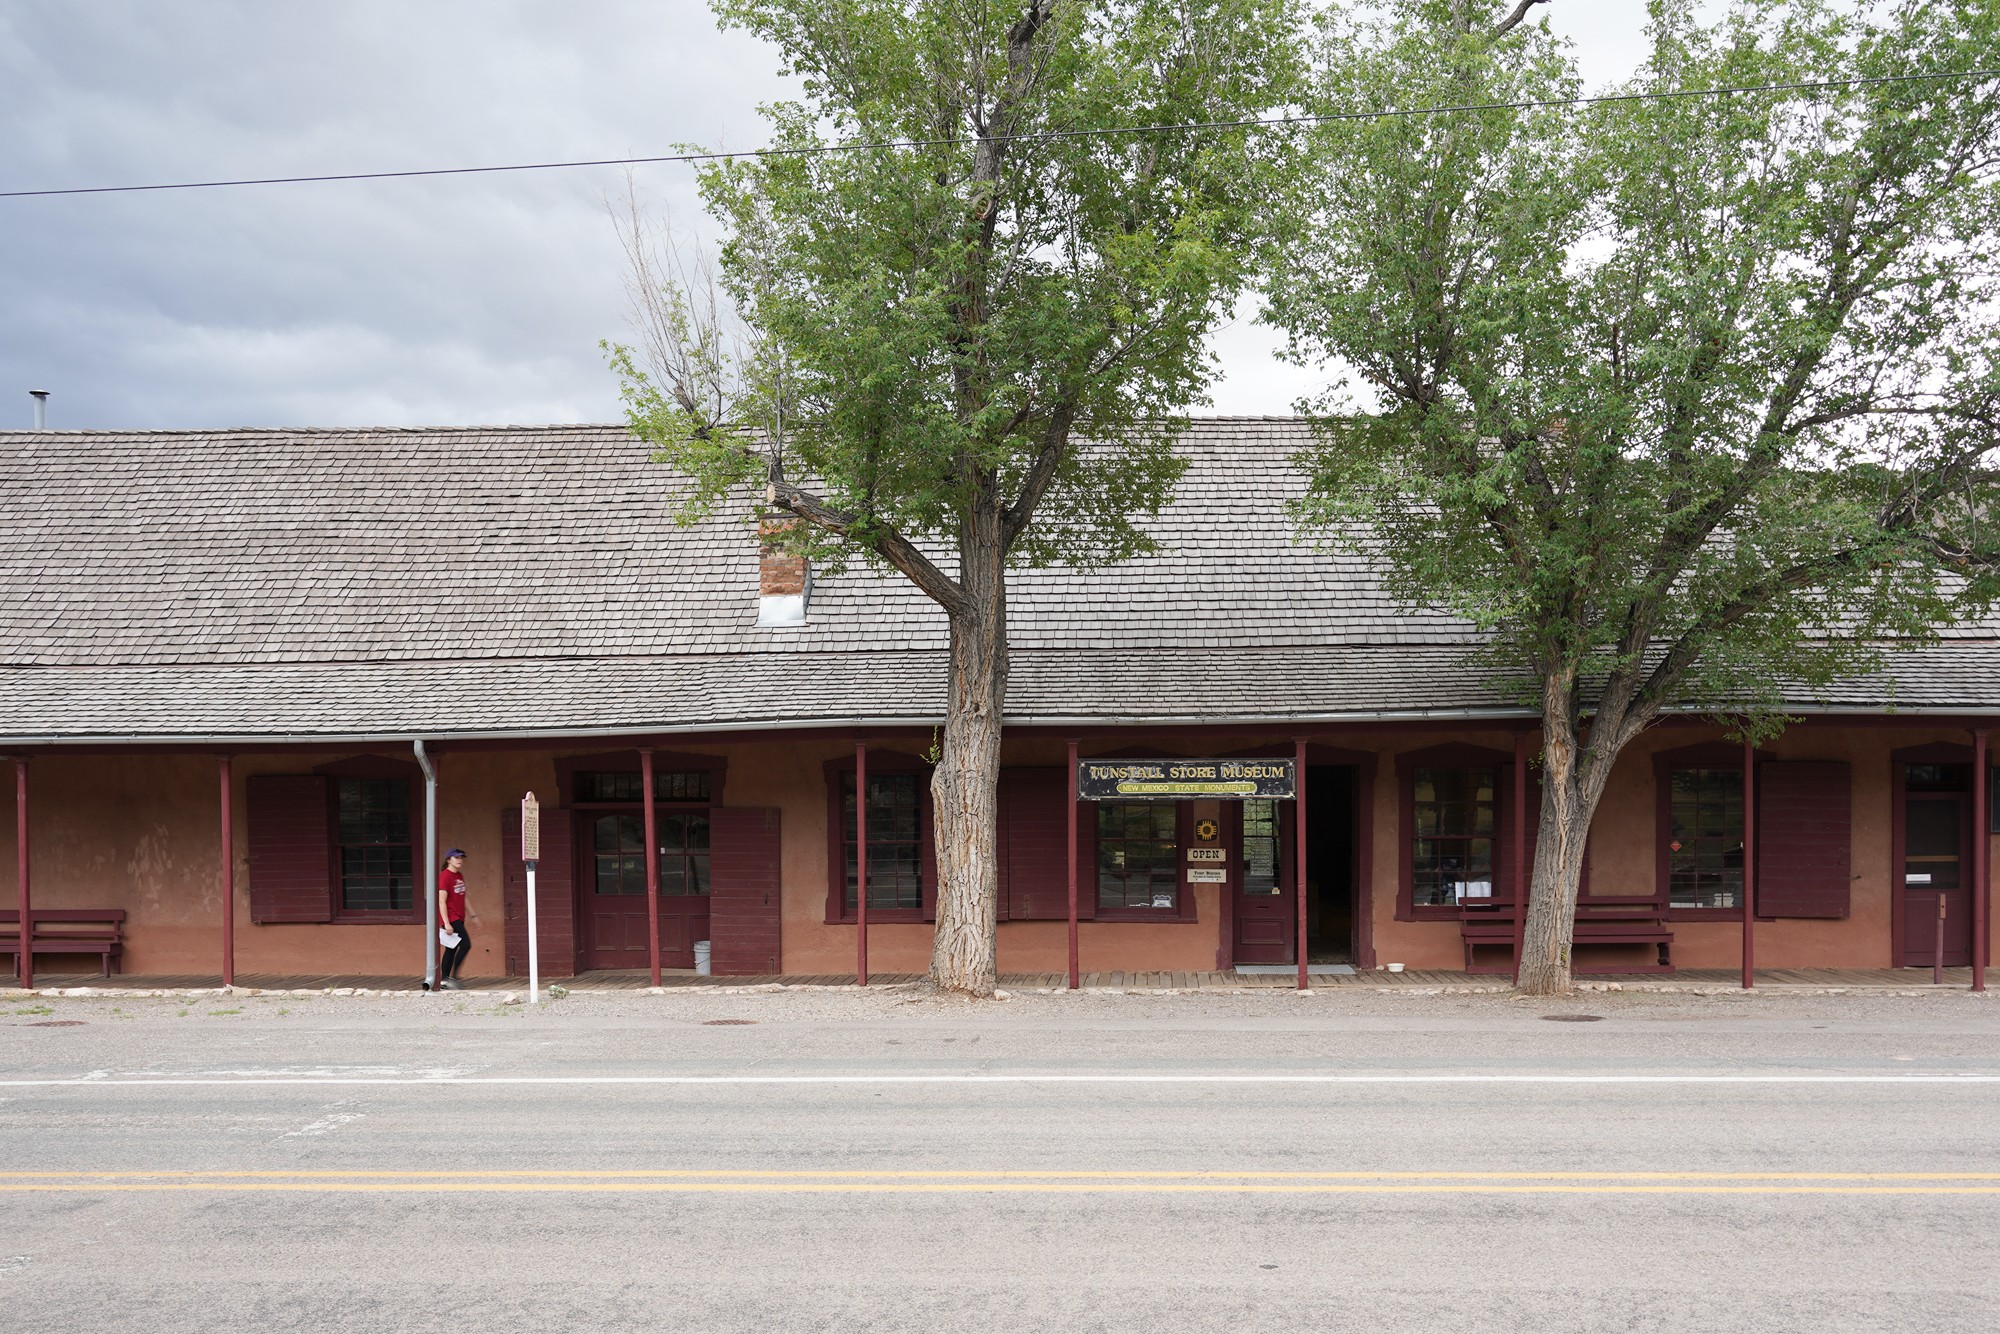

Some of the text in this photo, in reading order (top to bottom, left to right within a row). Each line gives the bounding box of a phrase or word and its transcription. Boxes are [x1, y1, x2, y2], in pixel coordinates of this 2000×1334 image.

[1090, 766, 1284, 779] TUNSTALL STORE MUSEUM
[1192, 850, 1220, 858] OPEN
